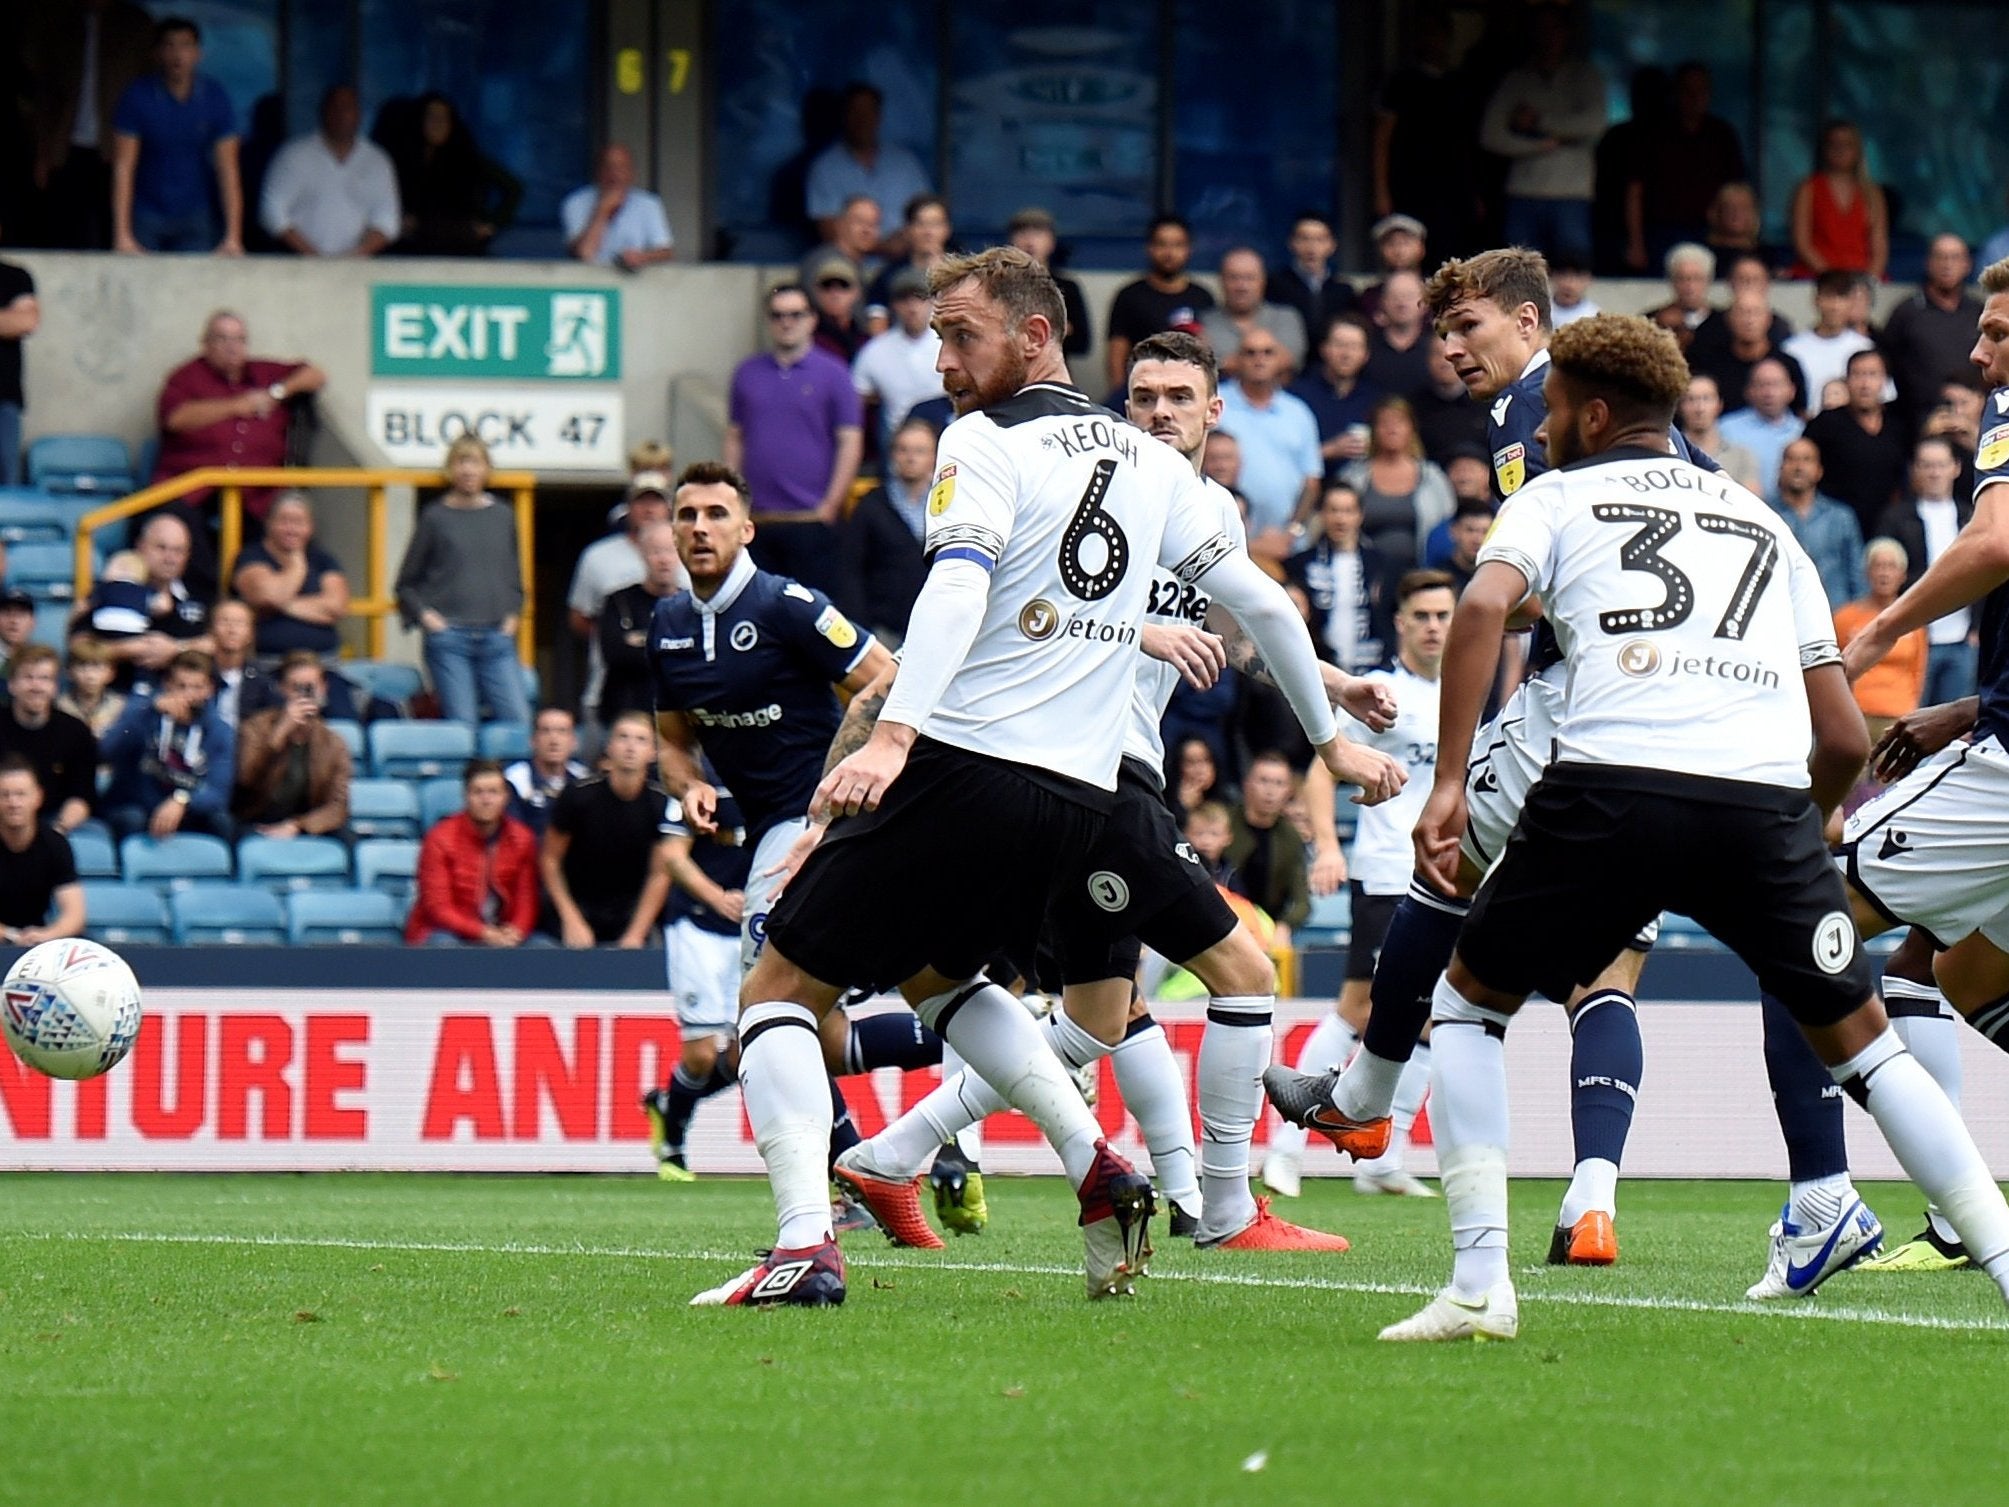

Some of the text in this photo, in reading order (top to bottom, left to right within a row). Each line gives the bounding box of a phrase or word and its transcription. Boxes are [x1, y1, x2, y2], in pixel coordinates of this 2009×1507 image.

[668, 48, 691, 96] 7
[384, 302, 530, 360] EXIT
[384, 409, 606, 447] BLOCK 47
[1053, 421, 1137, 468] KEOGH
[1058, 458, 1130, 601] 6
[1591, 503, 1778, 641] 37
[1668, 650, 1779, 689] jetcoin
[692, 704, 783, 728] inage
[0, 1013, 369, 1139] URE
[1578, 1075, 1613, 1088] MFC
